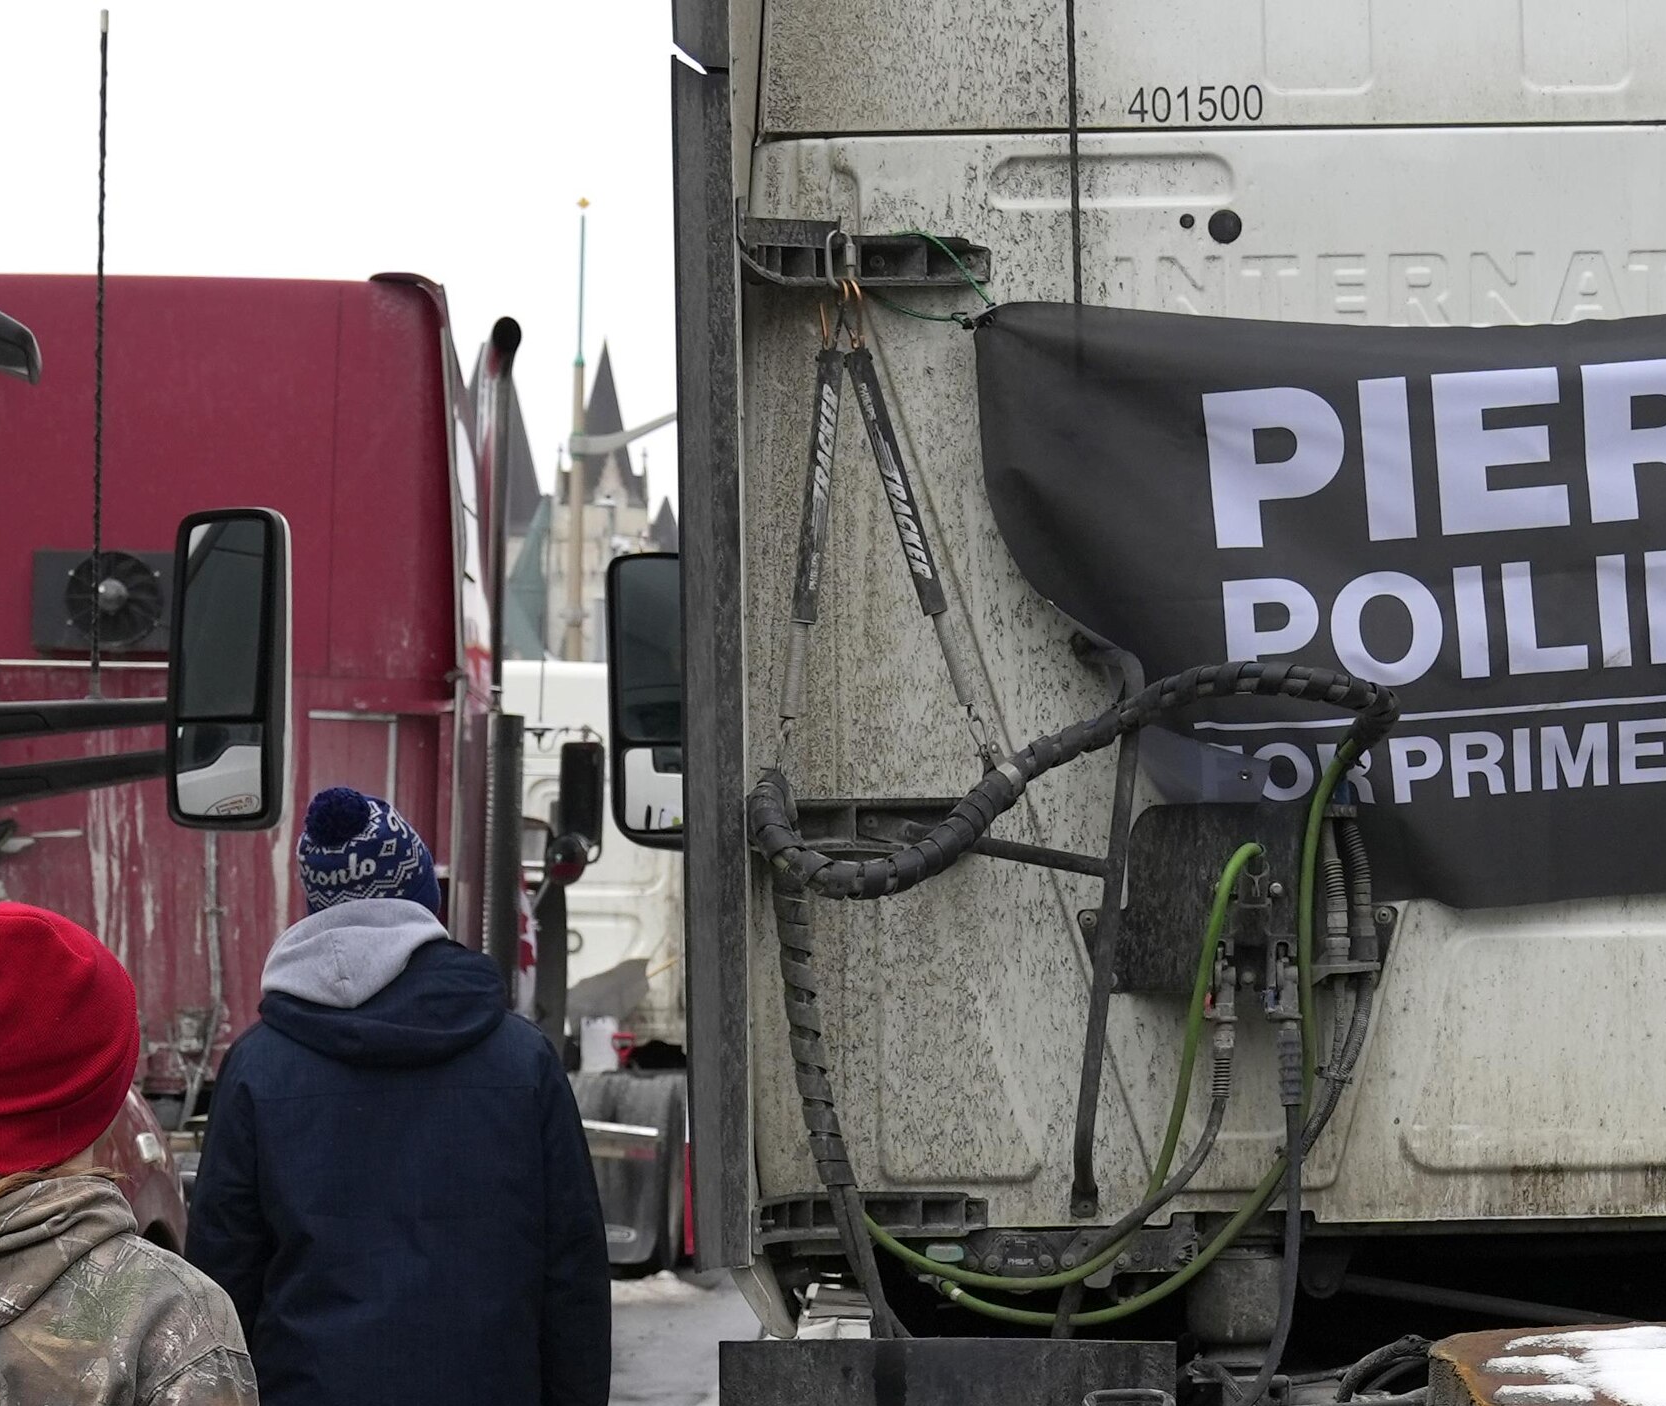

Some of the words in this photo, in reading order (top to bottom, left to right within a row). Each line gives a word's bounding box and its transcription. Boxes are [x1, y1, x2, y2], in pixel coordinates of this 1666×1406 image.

[1127, 84, 1264, 123] 401500
[812, 383, 838, 500] TRACKER
[882, 467, 933, 579] TRACKER
[1205, 741, 1376, 803] OR
[300, 853, 377, 885] ronto
